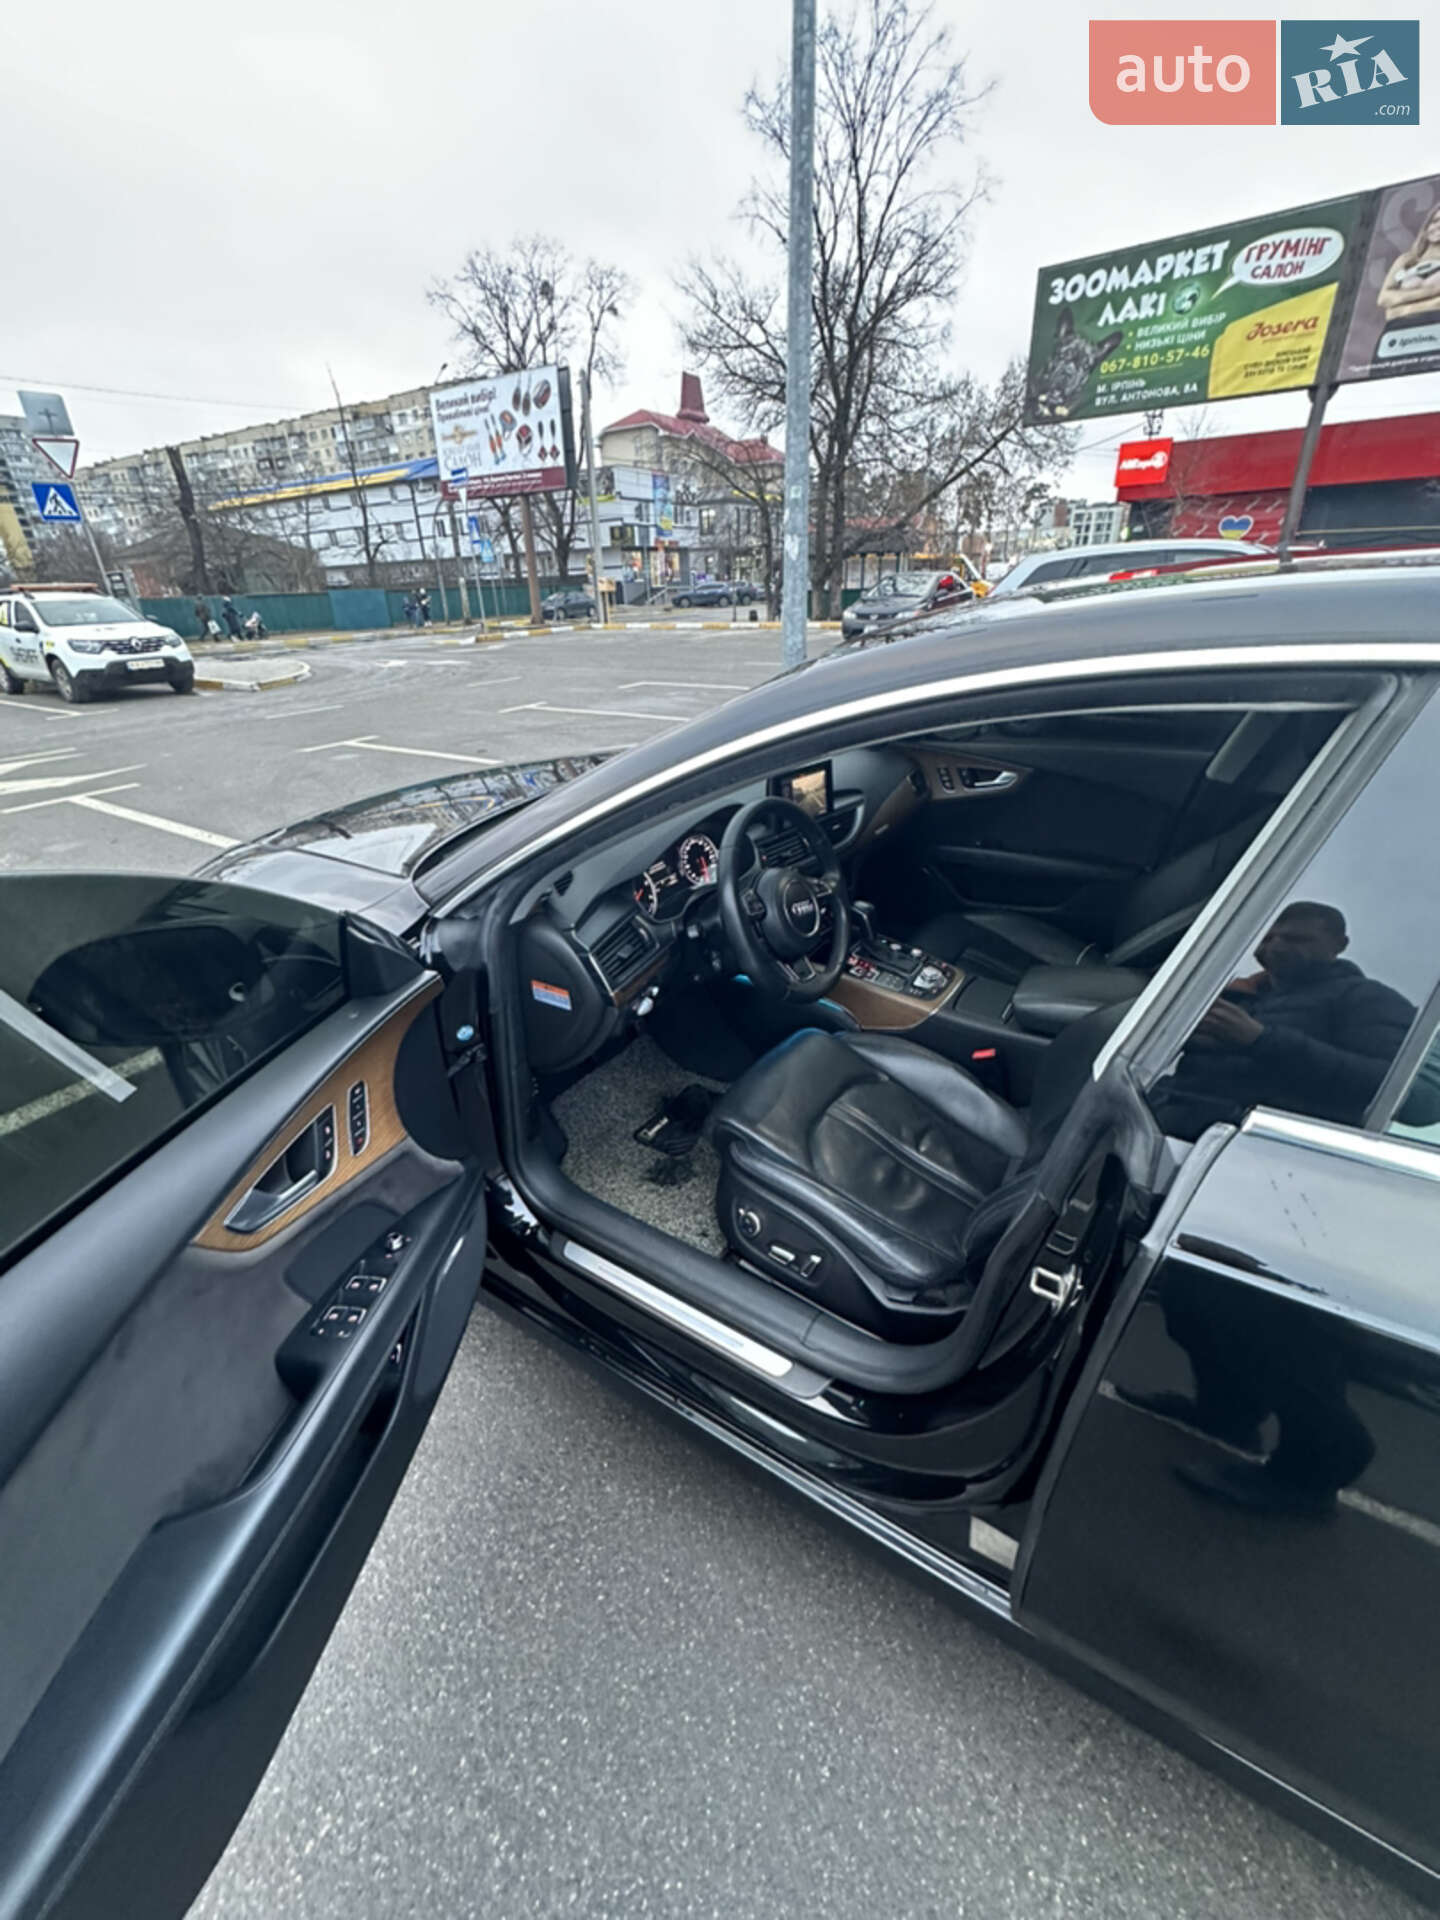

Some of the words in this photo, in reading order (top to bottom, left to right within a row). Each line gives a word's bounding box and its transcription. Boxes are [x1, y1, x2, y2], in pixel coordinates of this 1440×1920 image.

[1244, 237, 1333, 264] ГРУМІНГ
[1049, 240, 1230, 304] ЗООМАРКЕТ
[1250, 260, 1305, 279] САЛОН
[1097, 292, 1166, 327] ЛАКІ
[1136, 317, 1189, 338] ВЕЛИКИЙ
[1246, 316, 1320, 341] Josera
[1100, 344, 1210, 374] 067-810-57-46
